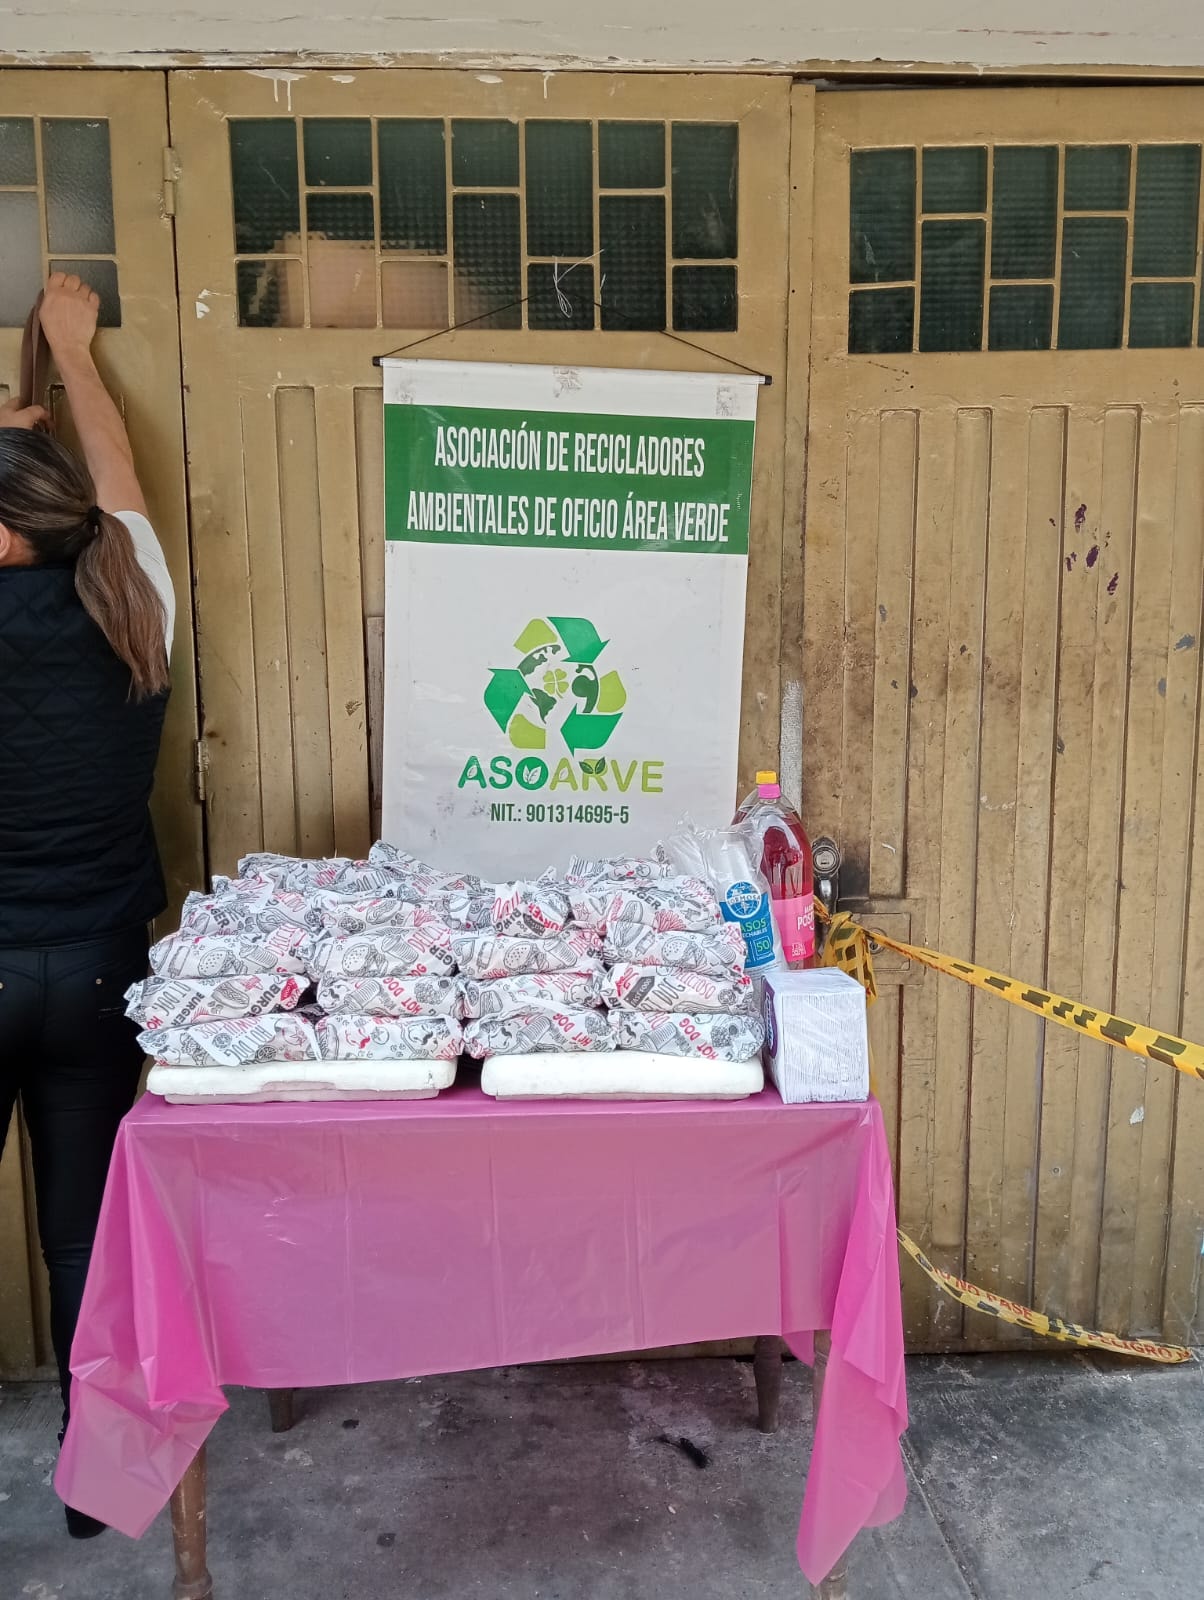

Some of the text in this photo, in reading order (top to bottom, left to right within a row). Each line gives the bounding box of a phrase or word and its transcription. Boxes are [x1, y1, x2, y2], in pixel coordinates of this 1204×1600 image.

[434, 421, 705, 478] ASOCIACIÓN DE RECICLADORES
[407, 490, 731, 542] AMBIENTALES DE OFICIO ÁREA VERDE
[457, 755, 665, 793] ASOARVE
[490, 803, 629, 824] NIT.: 901314695-5
[740, 917, 767, 933] ASOS
[756, 939, 770, 953] 50
[678, 1018, 702, 1041] DOG
